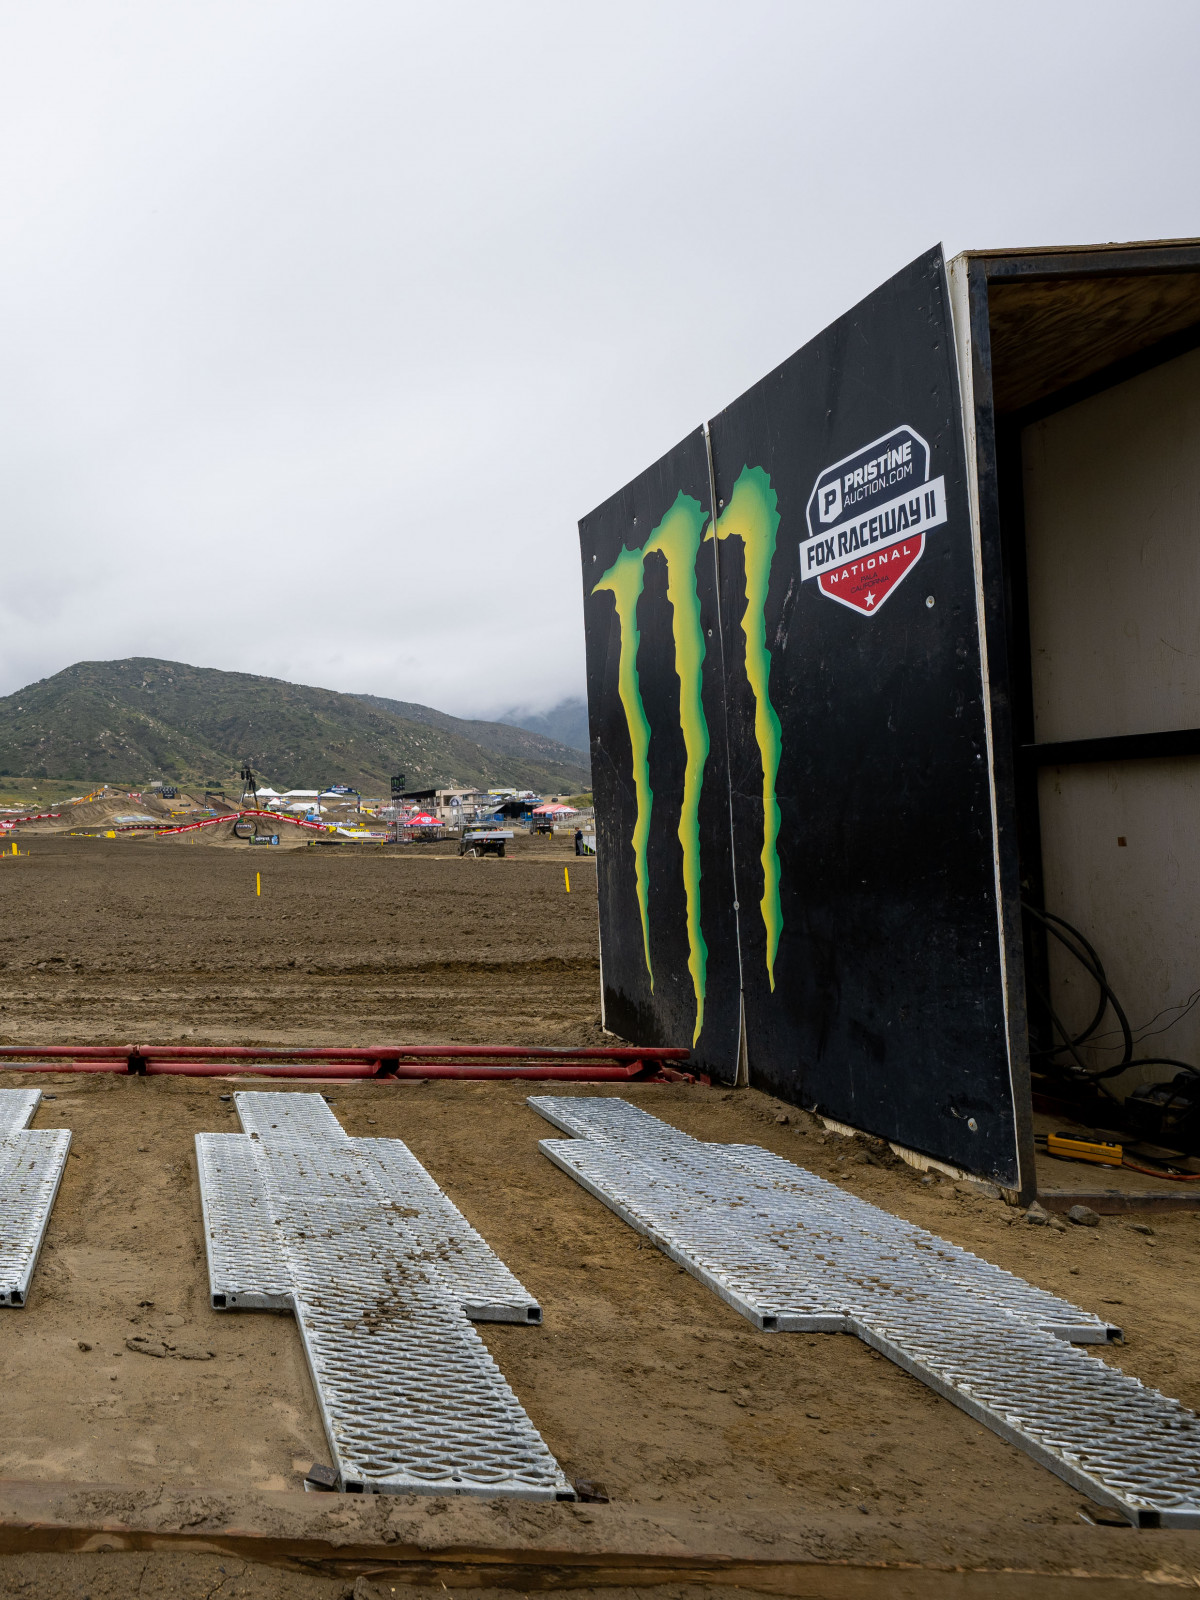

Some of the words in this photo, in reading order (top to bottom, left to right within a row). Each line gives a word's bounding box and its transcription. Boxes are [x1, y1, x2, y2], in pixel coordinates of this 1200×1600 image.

[843, 440, 912, 494] PRISTINE
[843, 461, 913, 508] AUCTION.COM
[807, 535, 836, 571] FOX
[837, 496, 922, 558] RACEWAY
[830, 545, 911, 584] NATIONAL
[850, 575, 890, 594] CALIFORNIA
[860, 572, 878, 583] PALA
